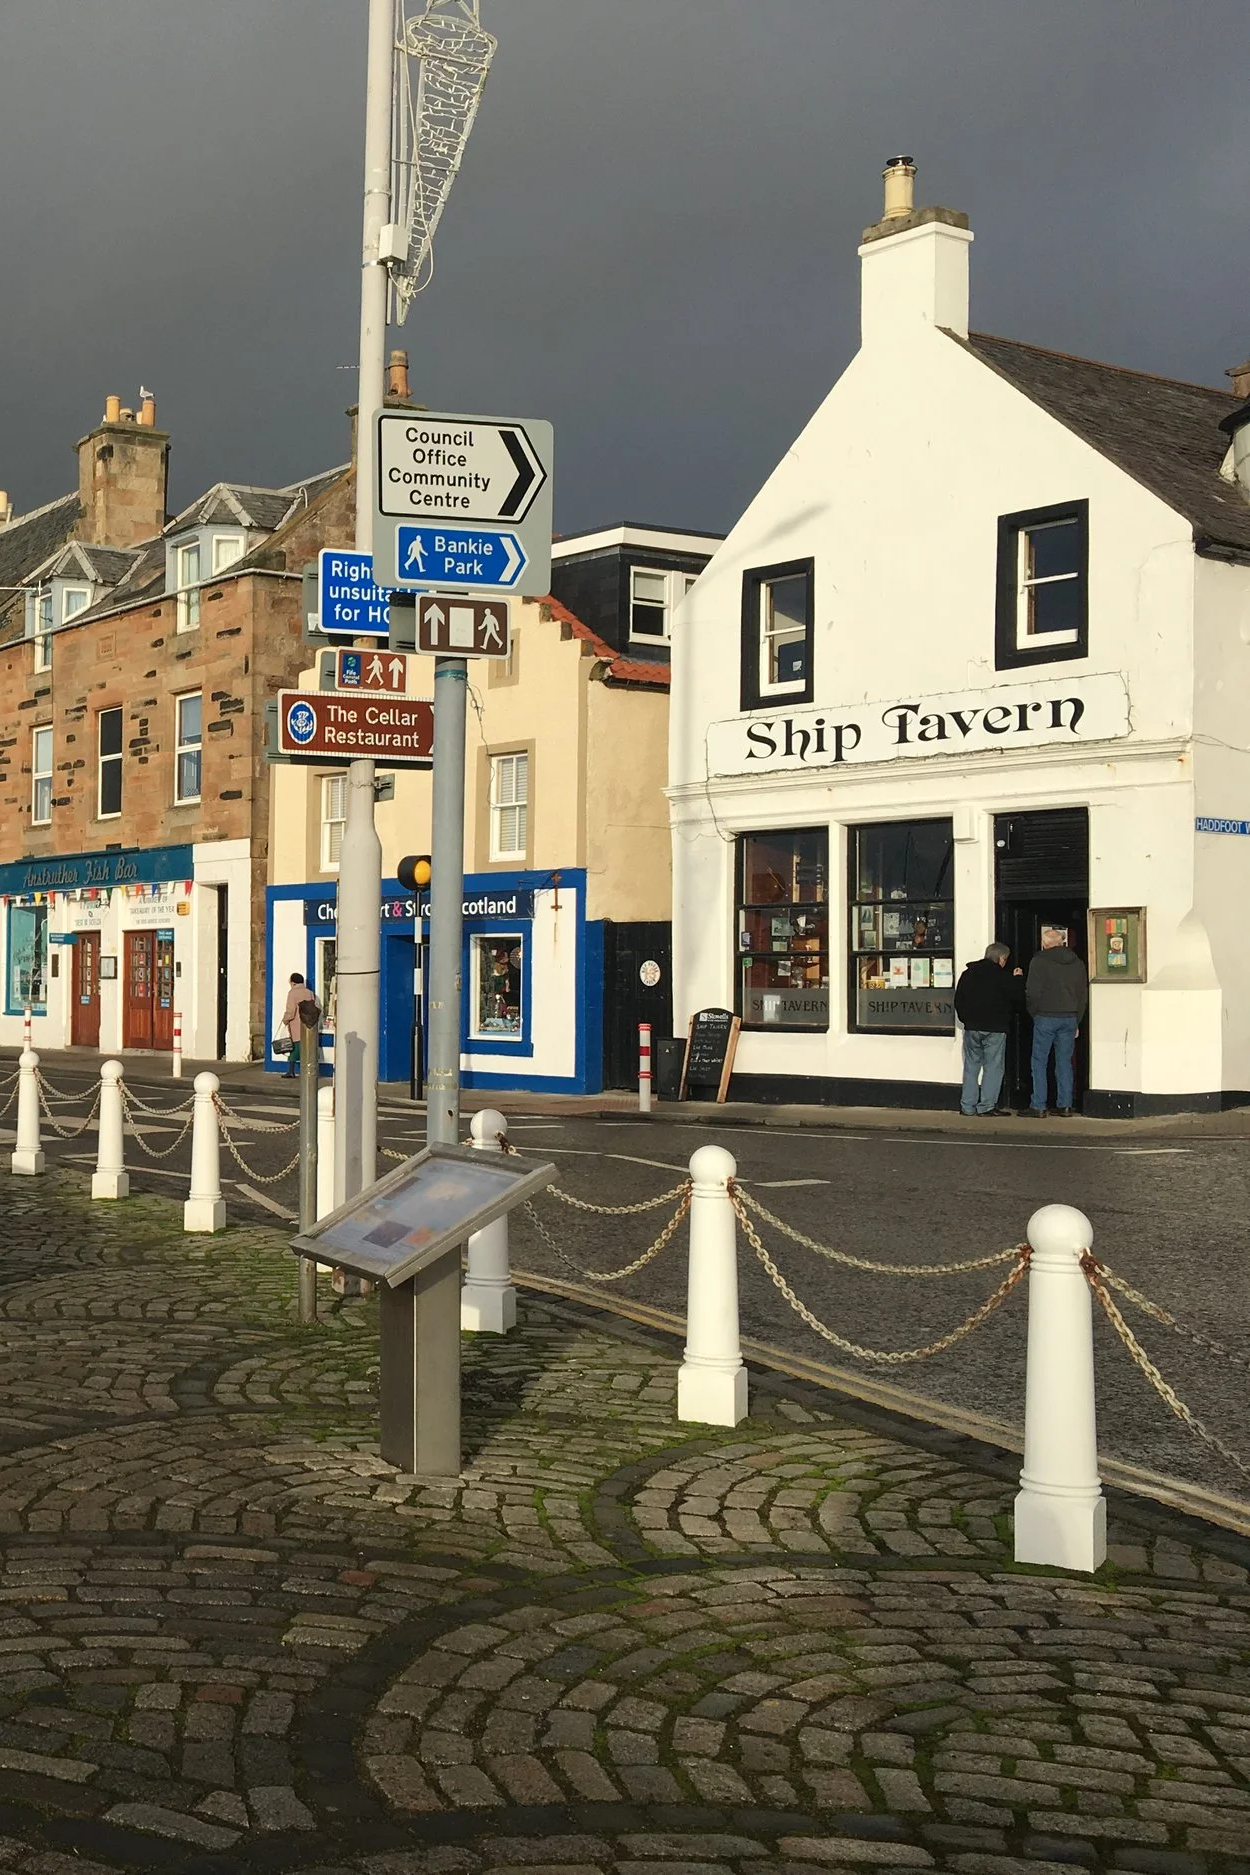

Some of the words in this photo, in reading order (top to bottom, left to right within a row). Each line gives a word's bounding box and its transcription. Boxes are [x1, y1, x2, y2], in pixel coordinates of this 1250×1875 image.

[405, 427, 474, 447] Council
[412, 448, 467, 466] Office
[388, 467, 491, 492] Community
[409, 489, 470, 508] Centre
[434, 536, 493, 555] Bankie
[444, 557, 483, 575] Park
[334, 604, 360, 621] for
[327, 705, 358, 723] The
[365, 707, 419, 726] Cellar
[324, 726, 420, 748] Restaurant
[744, 718, 862, 763] Ship
[881, 697, 1085, 746] Tavern
[1196, 818, 1243, 833] HADDFOOT
[23, 864, 79, 888] Anstruther
[83, 860, 110, 885] Fish
[114, 857, 137, 881] Bar
[392, 900, 402, 917] &
[461, 896, 517, 915] cotland
[782, 1000, 829, 1012] TAVERN
[868, 1001, 899, 1014] SHIP
[900, 1001, 954, 1014] TAVERN
